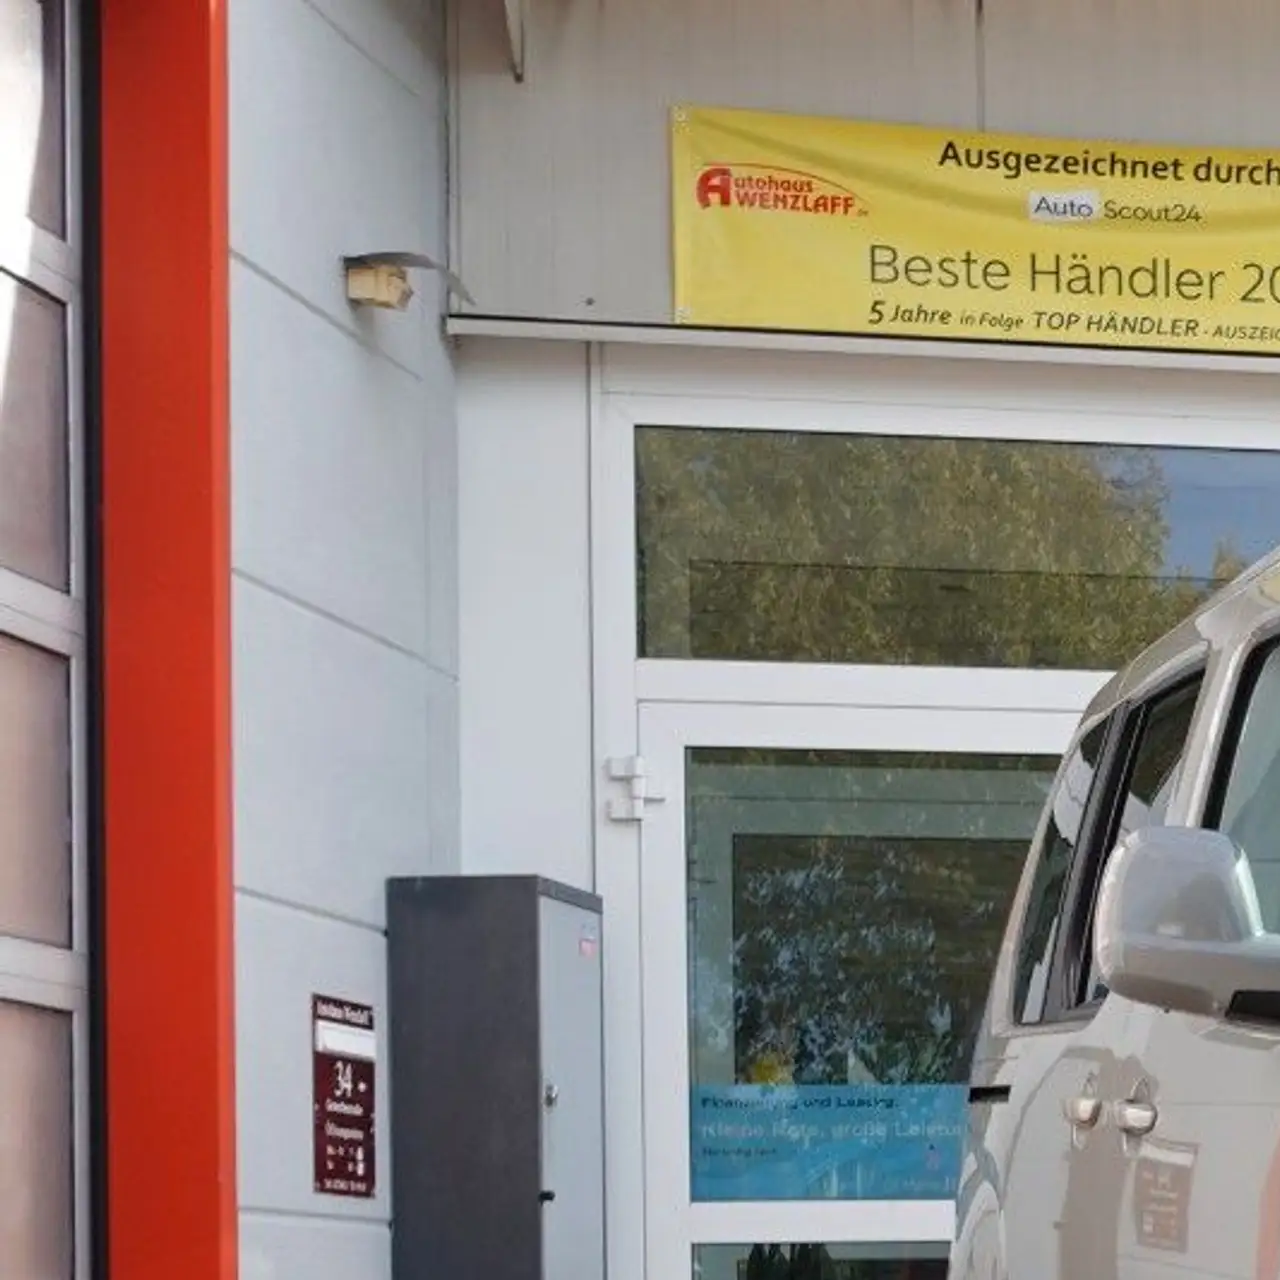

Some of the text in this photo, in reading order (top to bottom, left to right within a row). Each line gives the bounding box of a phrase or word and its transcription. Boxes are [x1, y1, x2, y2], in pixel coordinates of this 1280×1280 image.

[938, 141, 1185, 181] Ausgezeichnet
[735, 191, 855, 217] WENZLAFF
[1034, 196, 1203, 223] Auto Scout24
[870, 244, 1011, 291] Beste
[1030, 252, 1225, 302] Händler
[868, 300, 886, 325] 5
[889, 304, 952, 326] Jahre
[960, 313, 975, 325] in
[978, 313, 1025, 332] Folge
[1034, 311, 1081, 330] TOP
[1086, 310, 1199, 338] HÄNDLER
